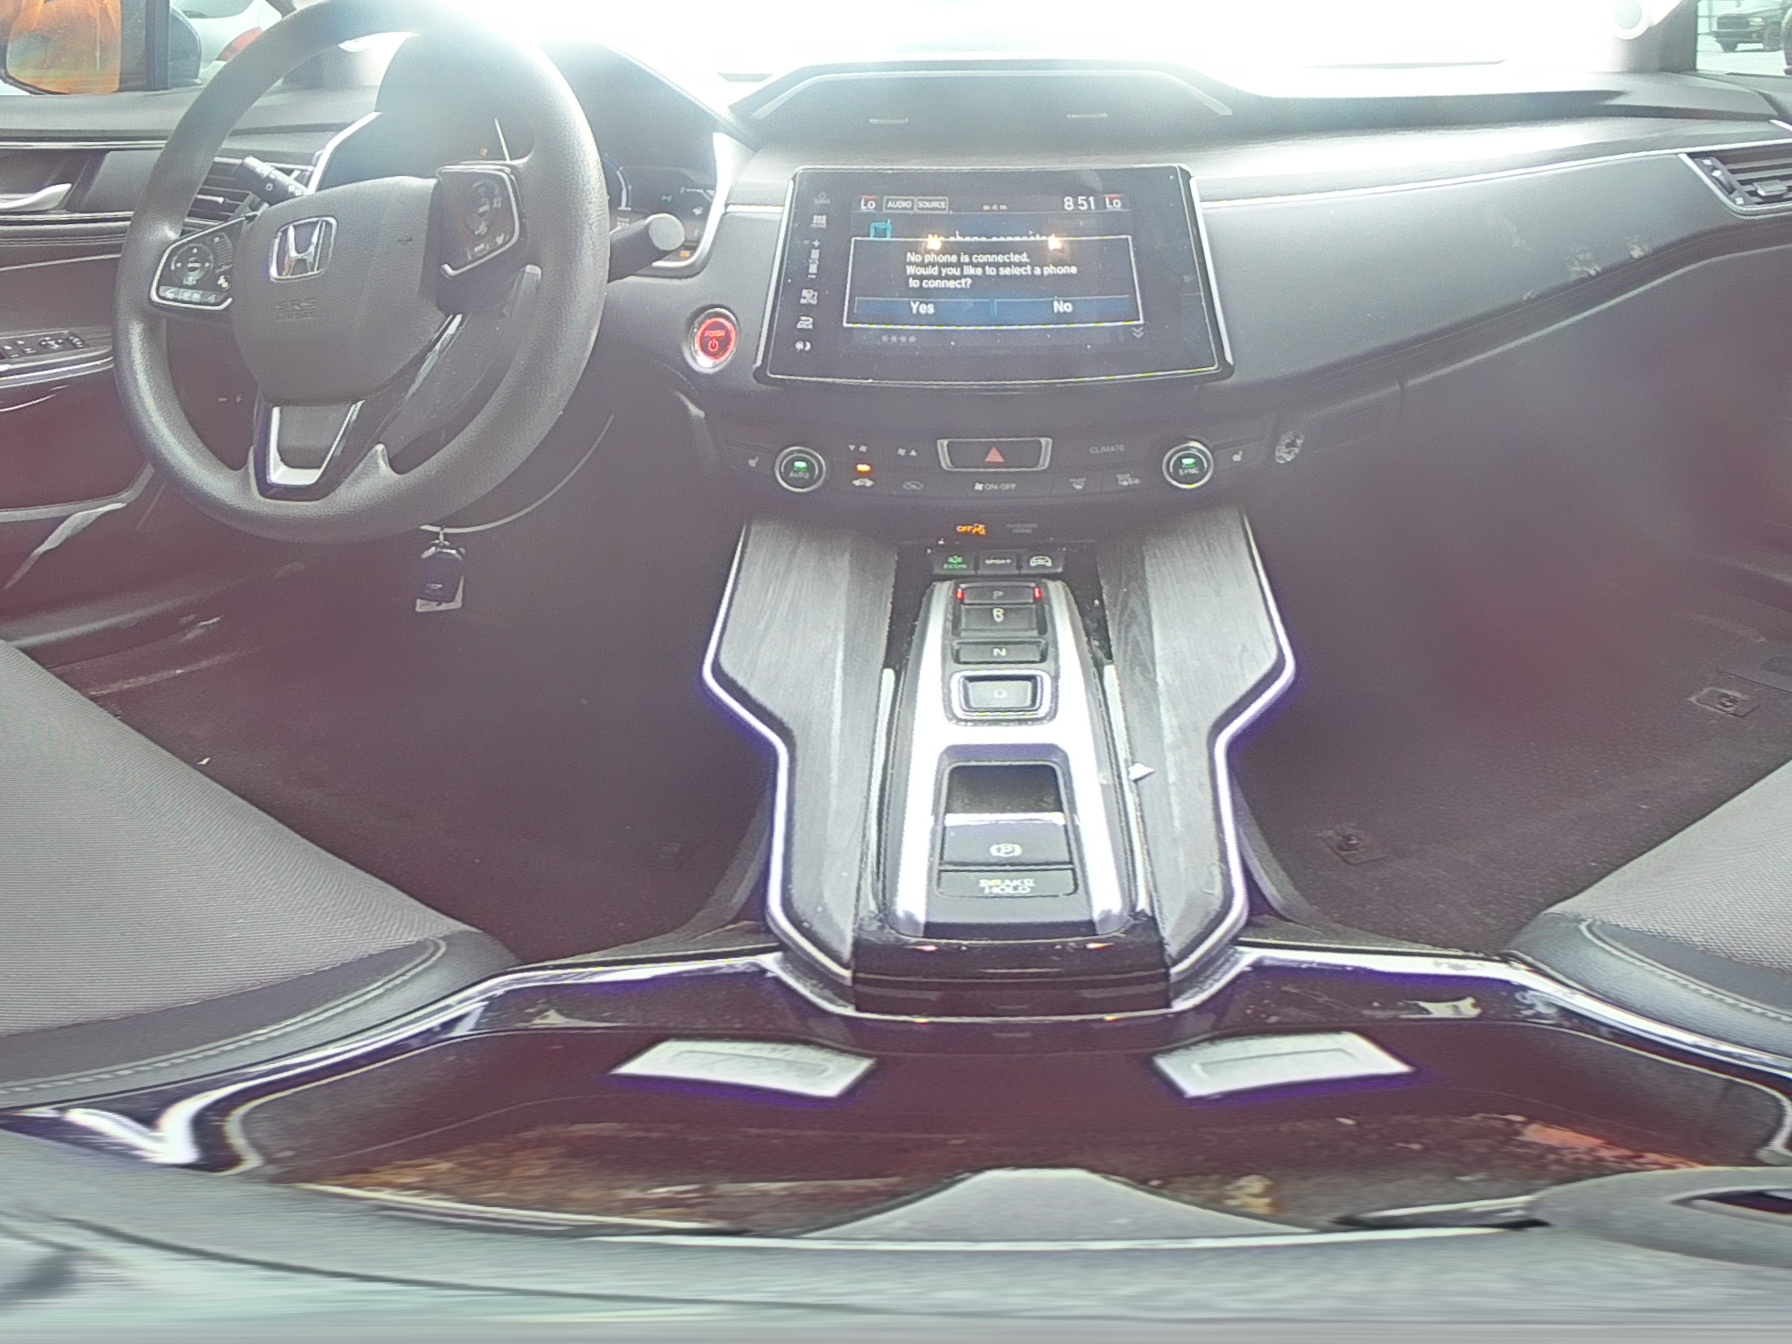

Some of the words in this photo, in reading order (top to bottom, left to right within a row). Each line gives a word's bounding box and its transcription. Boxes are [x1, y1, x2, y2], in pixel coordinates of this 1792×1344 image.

[861, 197, 876, 209] Lo
[887, 200, 912, 209] AUDIO
[918, 200, 946, 209] SOURCE
[1105, 197, 1122, 209] Lo
[906, 252, 922, 263] No
[924, 252, 957, 265] phone
[960, 252, 970, 263] is
[972, 251, 1031, 263] connected.
[906, 265, 939, 276] Would
[941, 267, 961, 277] you
[963, 265, 983, 276] like
[985, 265, 997, 276] to
[999, 265, 1031, 276] select
[1033, 267, 1042, 275] a
[1043, 264, 1078, 277] phone
[909, 278, 920, 289] to
[922, 277, 973, 289] connect?
[275, 298, 317, 313] SRS
[910, 300, 936, 315] Yes
[1053, 300, 1074, 313] No
[1089, 444, 1126, 455] CLIMATE
[789, 471, 810, 479] AUTO
[993, 590, 1004, 600] P
[993, 647, 1007, 657] N
[984, 885, 1031, 894] HOLD
